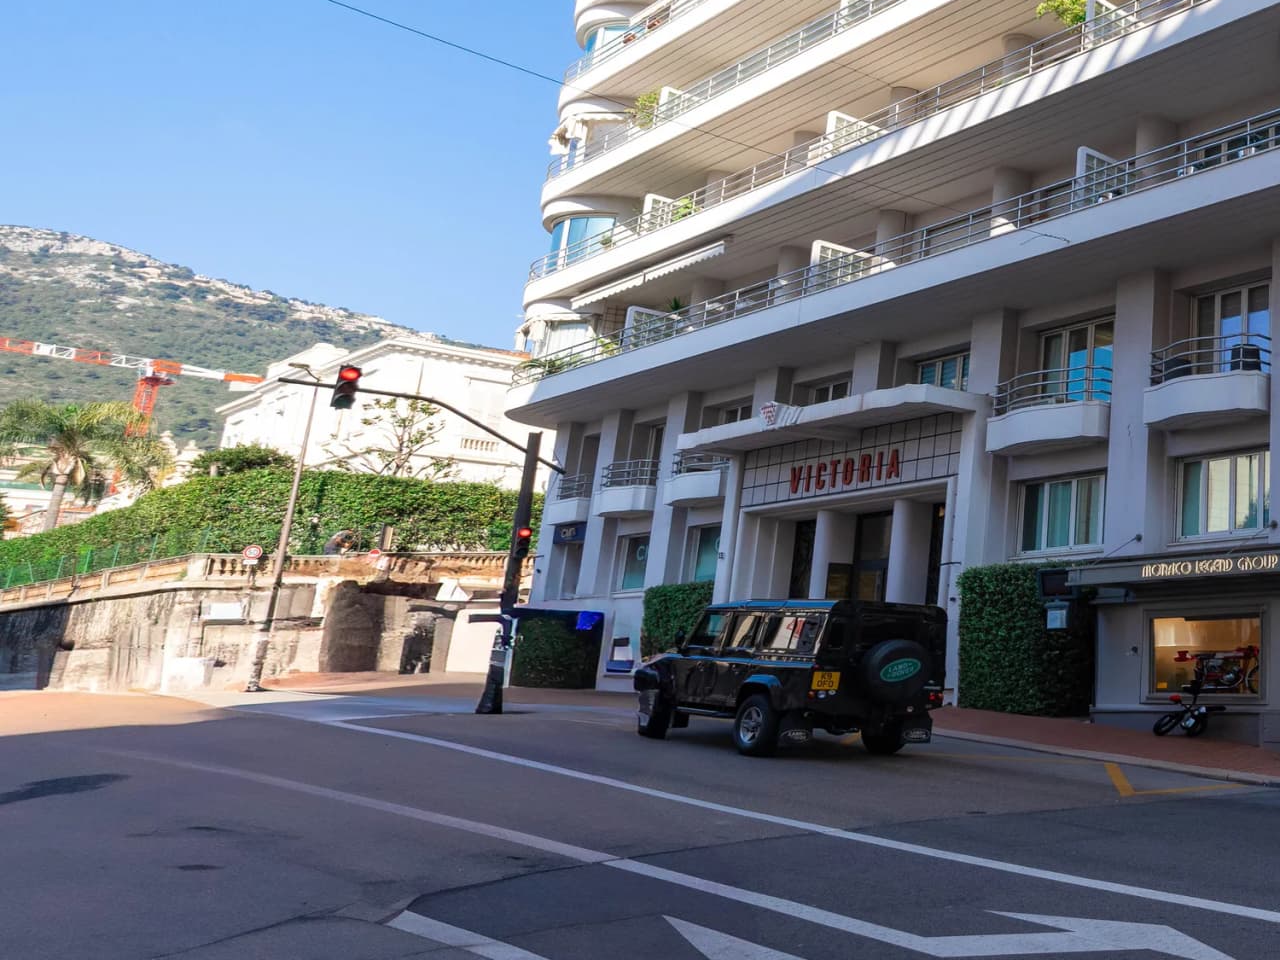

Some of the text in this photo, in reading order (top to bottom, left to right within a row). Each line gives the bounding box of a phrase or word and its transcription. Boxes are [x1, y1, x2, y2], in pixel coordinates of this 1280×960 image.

[790, 448, 900, 494] VICTORIA
[1142, 555, 1279, 577] MONACO LEGEND GROUP
